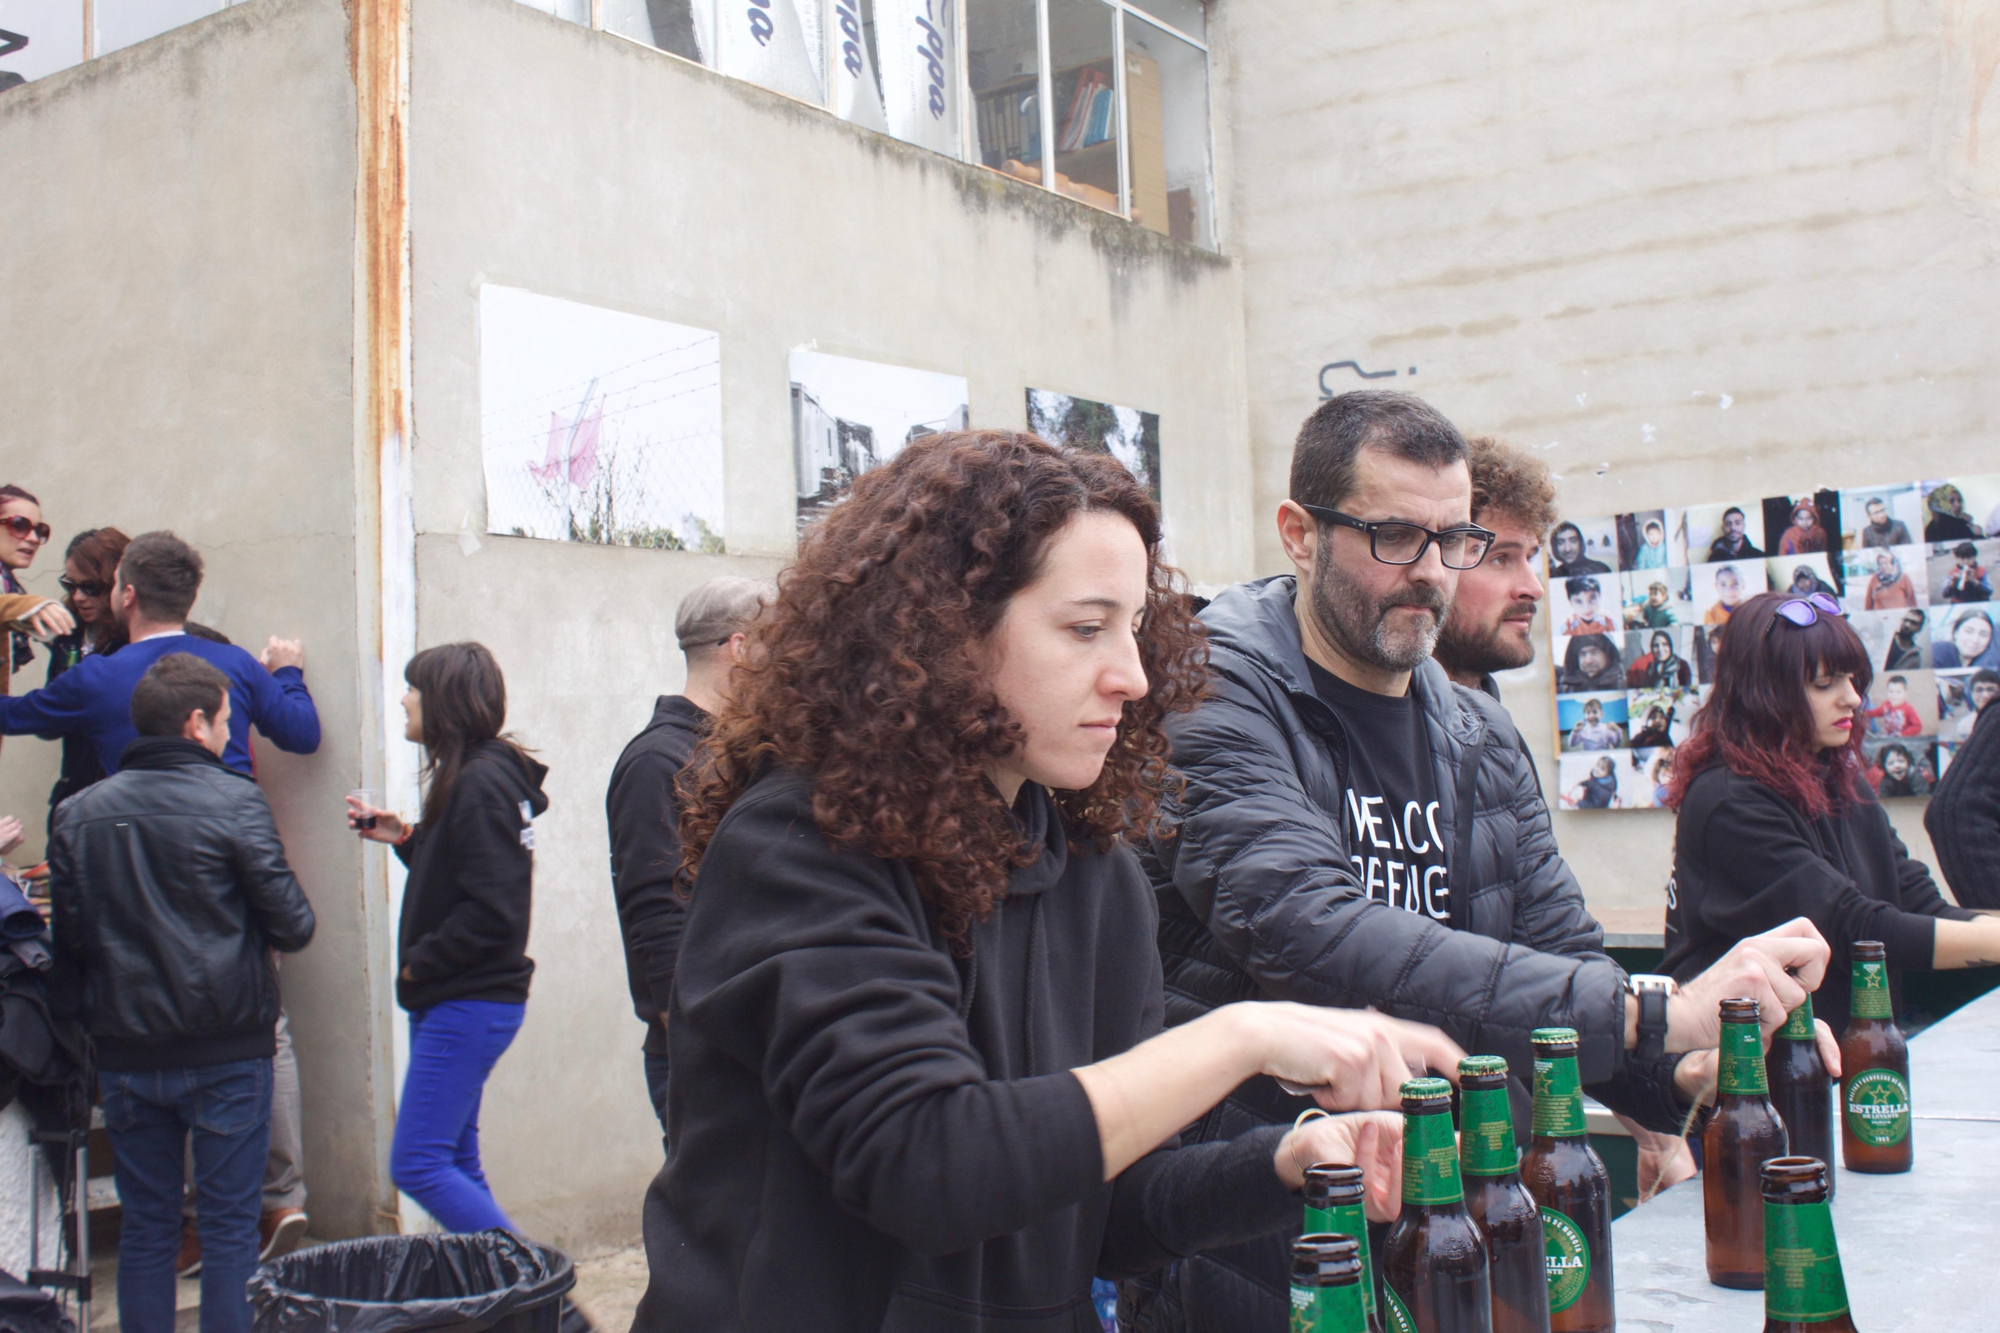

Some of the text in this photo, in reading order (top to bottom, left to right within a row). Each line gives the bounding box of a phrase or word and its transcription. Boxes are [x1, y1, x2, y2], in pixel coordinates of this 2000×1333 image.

[836, 0, 862, 79] pa
[915, 0, 947, 121] ppa
[1849, 1102, 1909, 1114] ESTRELLA
[1393, 1304, 1409, 1333] MURCI
